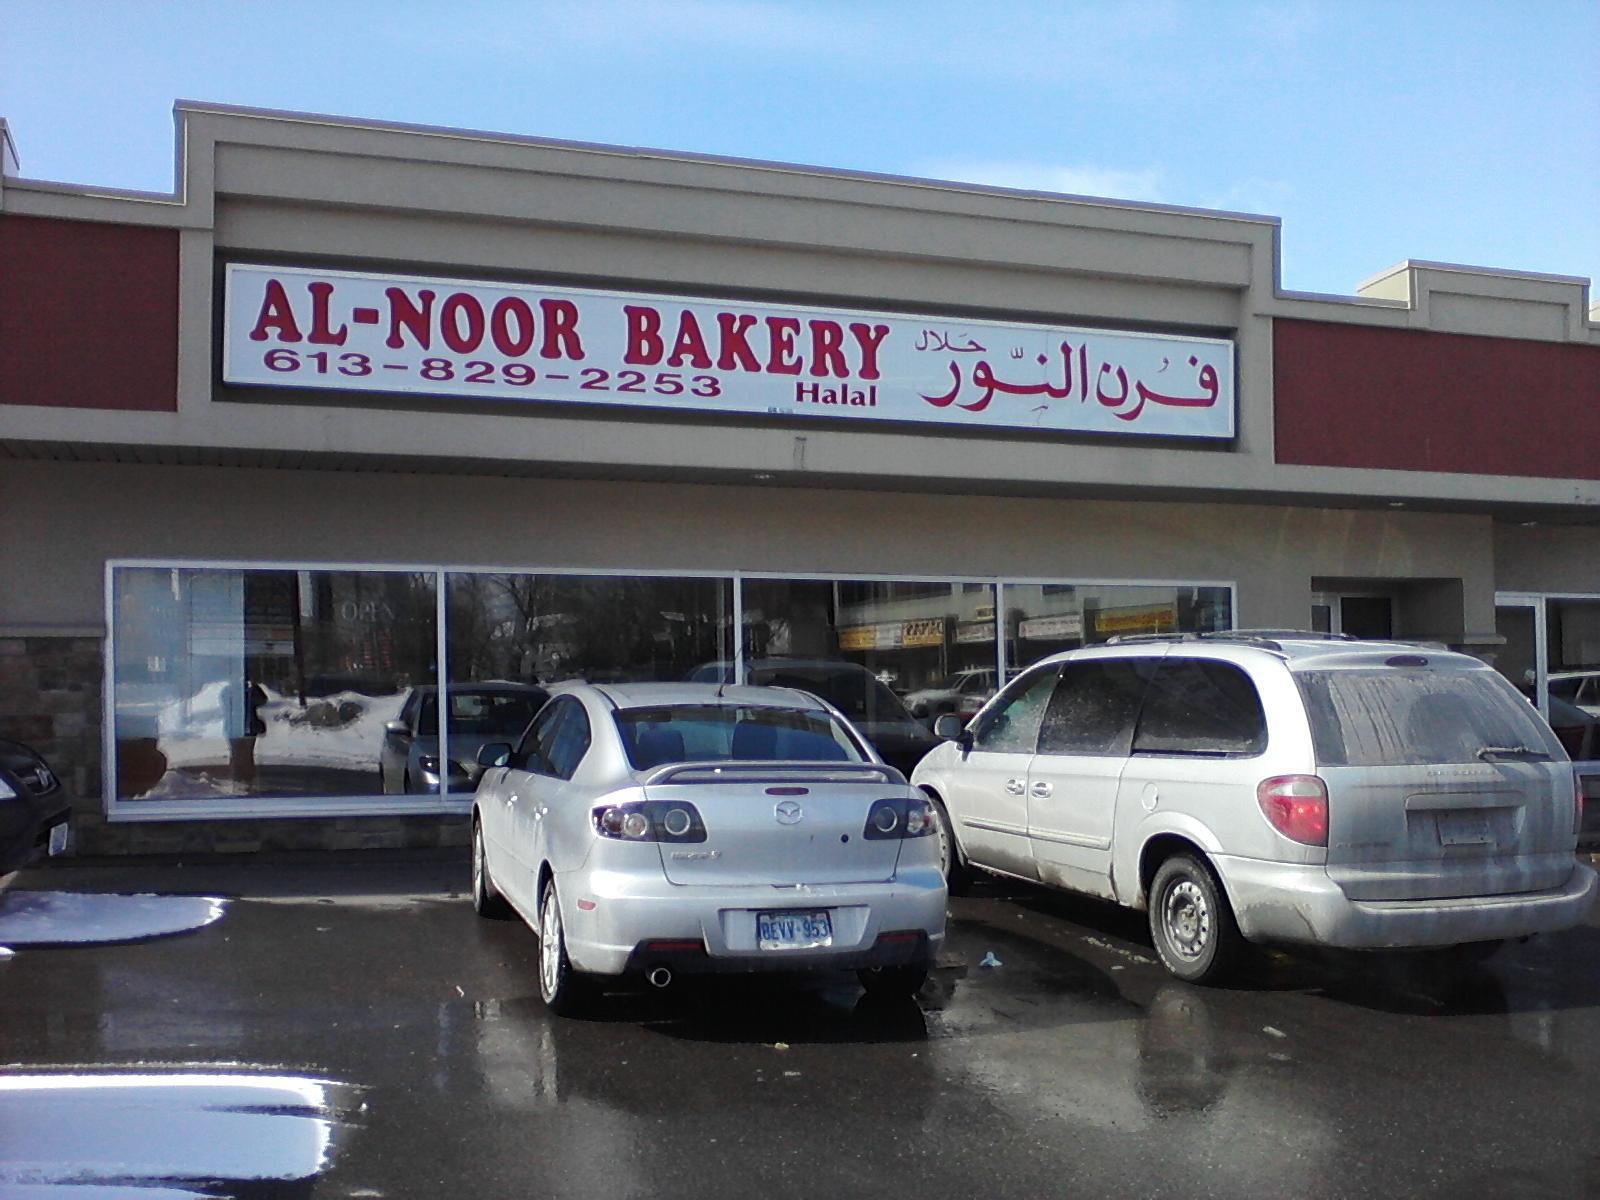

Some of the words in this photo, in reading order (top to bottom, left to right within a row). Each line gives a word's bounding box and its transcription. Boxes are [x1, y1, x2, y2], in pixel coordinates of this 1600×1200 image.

[249, 278, 586, 361] AL-NOOR
[623, 304, 890, 381] BAKERY
[263, 348, 721, 398] 613-829-2253
[796, 381, 877, 407] Halal
[803, 918, 829, 938] 953
